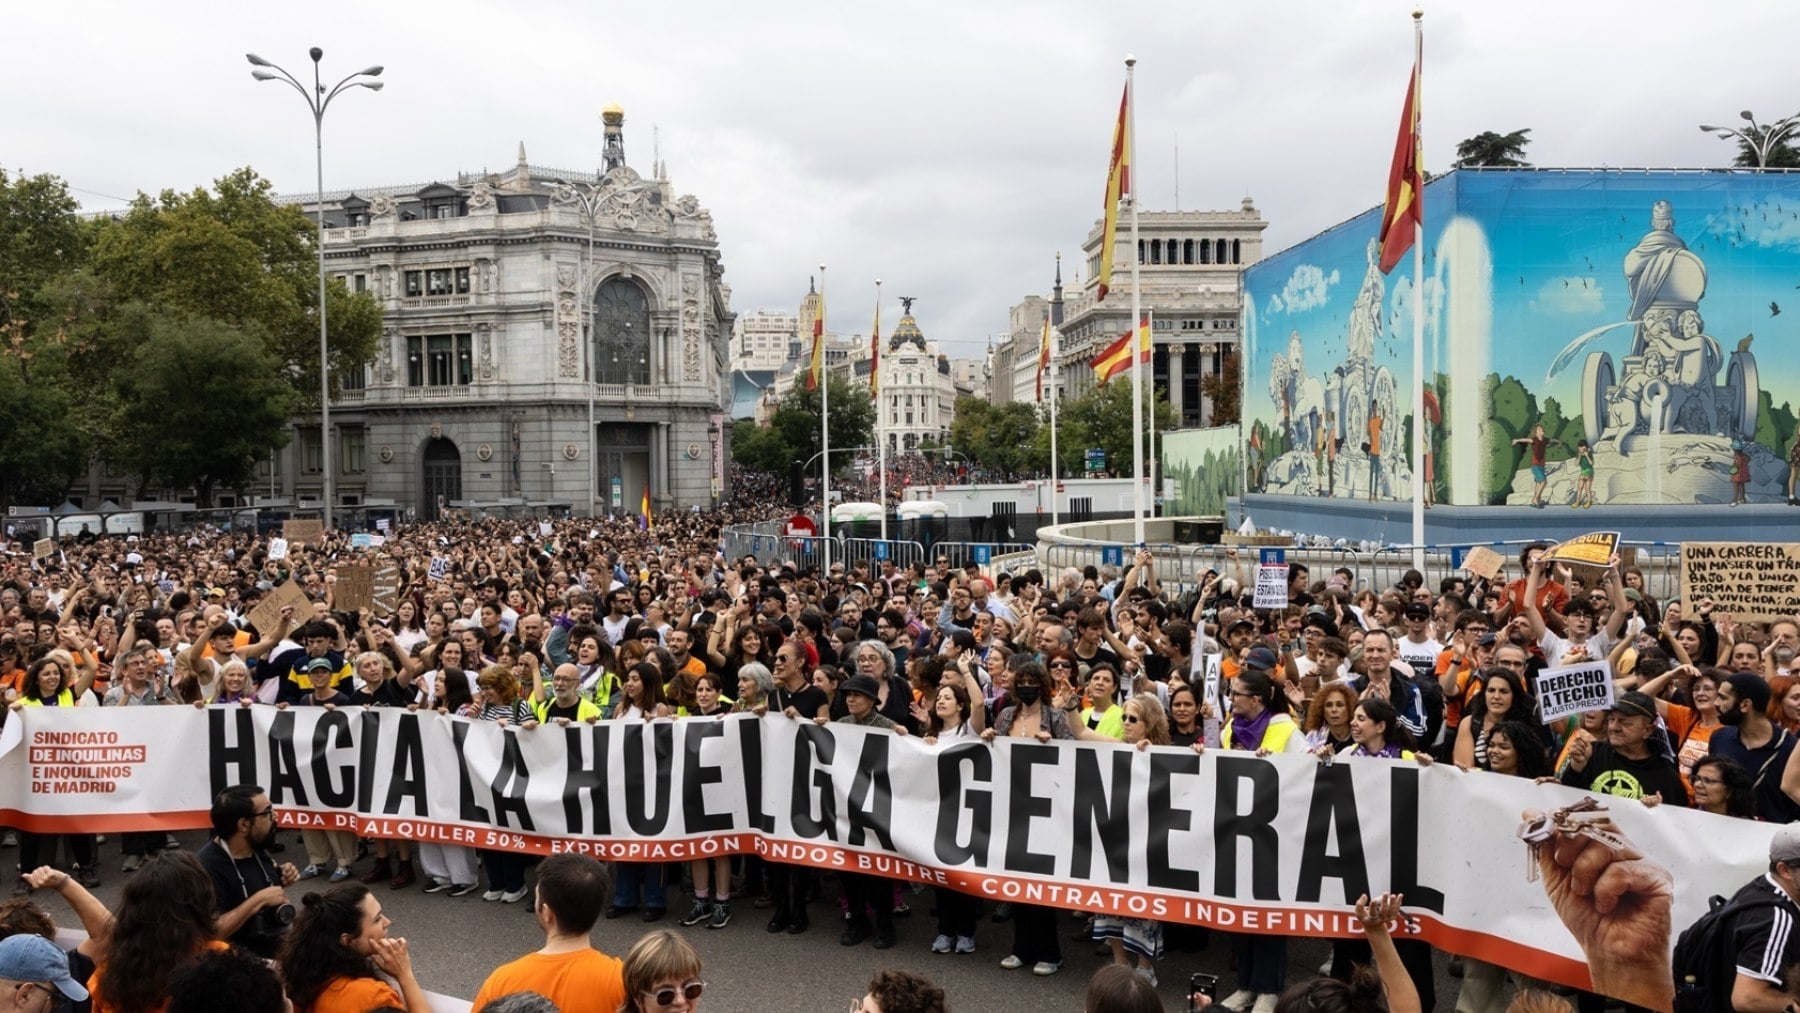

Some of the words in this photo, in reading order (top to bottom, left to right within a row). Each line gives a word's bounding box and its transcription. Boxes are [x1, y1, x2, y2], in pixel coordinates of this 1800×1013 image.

[1686, 546, 1716, 560] UNA
[1687, 561, 1707, 573] UN
[1756, 560, 1774, 571] UN
[1729, 572, 1738, 581] Y
[1738, 572, 1754, 581] LA
[1689, 583, 1734, 594] FORMA
[1736, 584, 1753, 594] DE
[1755, 584, 1795, 594] TENER
[1750, 605, 1767, 614] MI
[1540, 669, 1605, 694] DERECHO
[1542, 695, 1552, 709] A
[1553, 684, 1607, 705] TECHO
[1551, 703, 1575, 715] JUSTO
[33, 731, 119, 746] SINDICATO
[32, 748, 55, 762] DE
[56, 747, 144, 763] INQUILINAS
[32, 766, 41, 779] E
[44, 765, 132, 780] INQUILINOS
[32, 780, 51, 794] DE
[53, 780, 117, 794] MADRID
[208, 708, 429, 818] HACIA
[452, 720, 536, 832] LA
[562, 718, 899, 853] HUELGA
[934, 742, 1445, 916] GENERAL
[335, 814, 358, 832] DE
[363, 819, 476, 844] ALQUILER
[485, 832, 527, 851] 50%
[551, 835, 742, 858] EXPROPIACIÓN
[754, 838, 846, 866] FONDOS
[858, 854, 949, 886] BUITRE
[981, 878, 1169, 917] CONTRATOS
